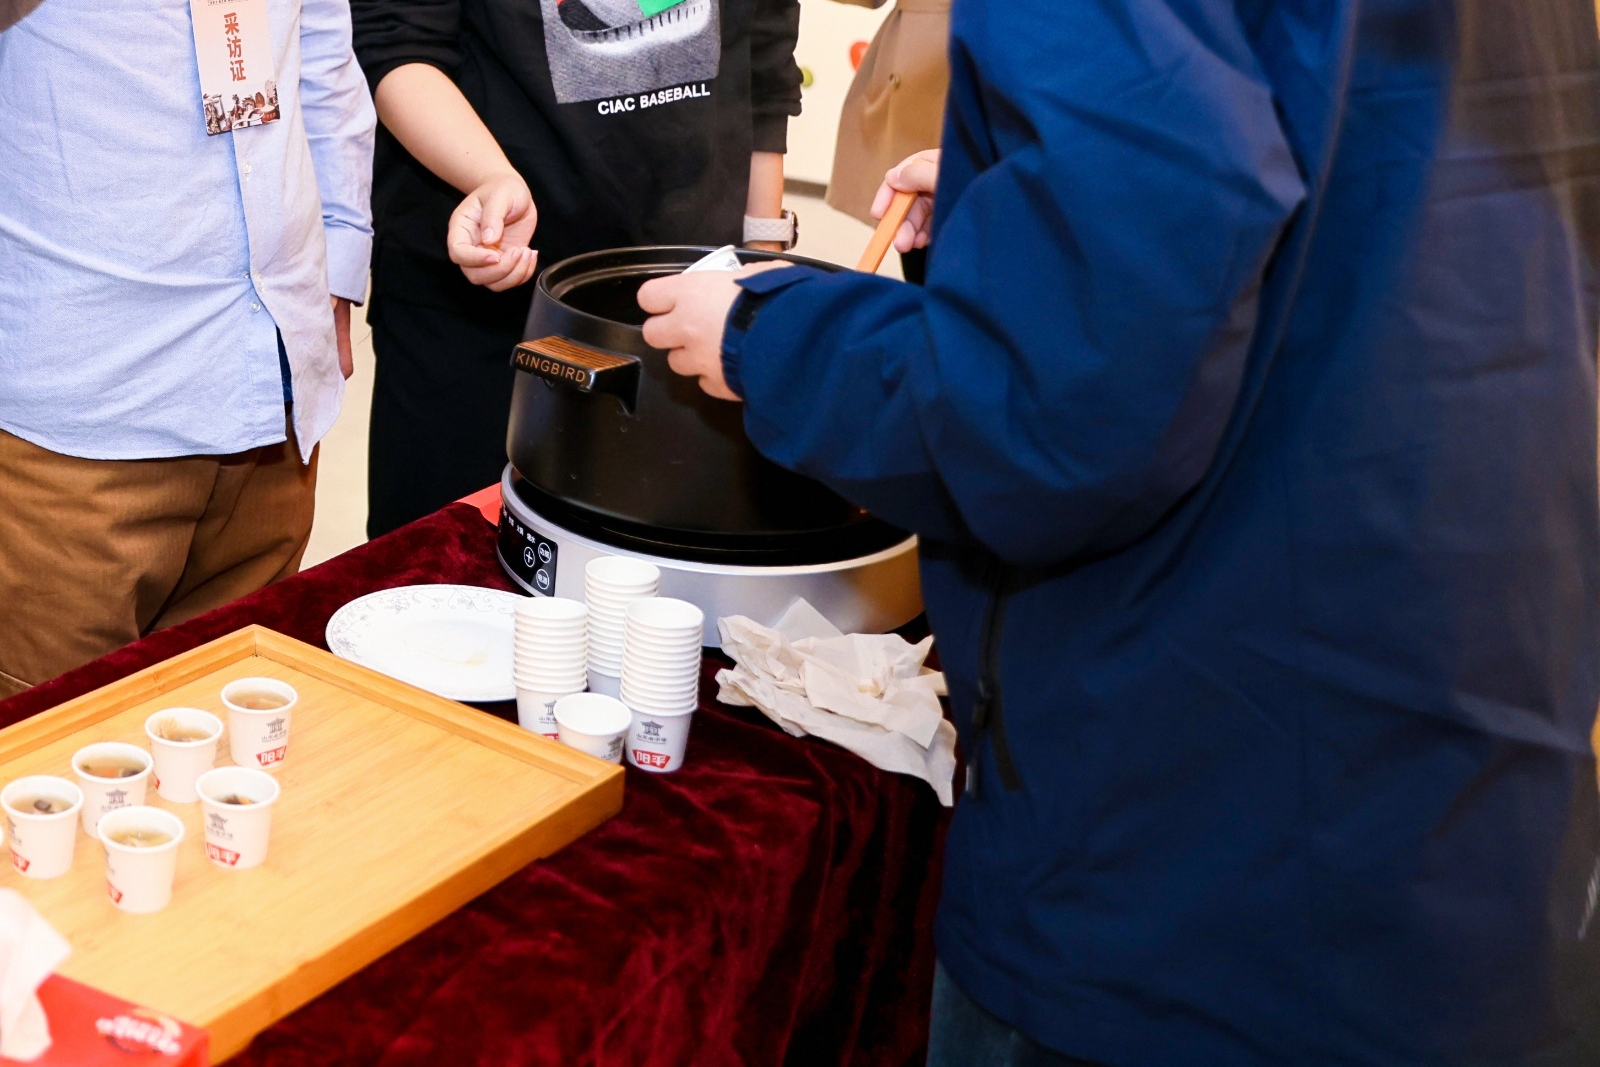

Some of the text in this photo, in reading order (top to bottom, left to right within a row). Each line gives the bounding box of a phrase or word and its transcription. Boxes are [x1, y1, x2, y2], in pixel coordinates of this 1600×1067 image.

[223, 11, 247, 82] 采访证
[597, 83, 711, 115] CIAC BASEBALL
[516, 351, 587, 383] KINGBIRD
[260, 747, 285, 764] 阳平
[636, 751, 667, 766] 阳平
